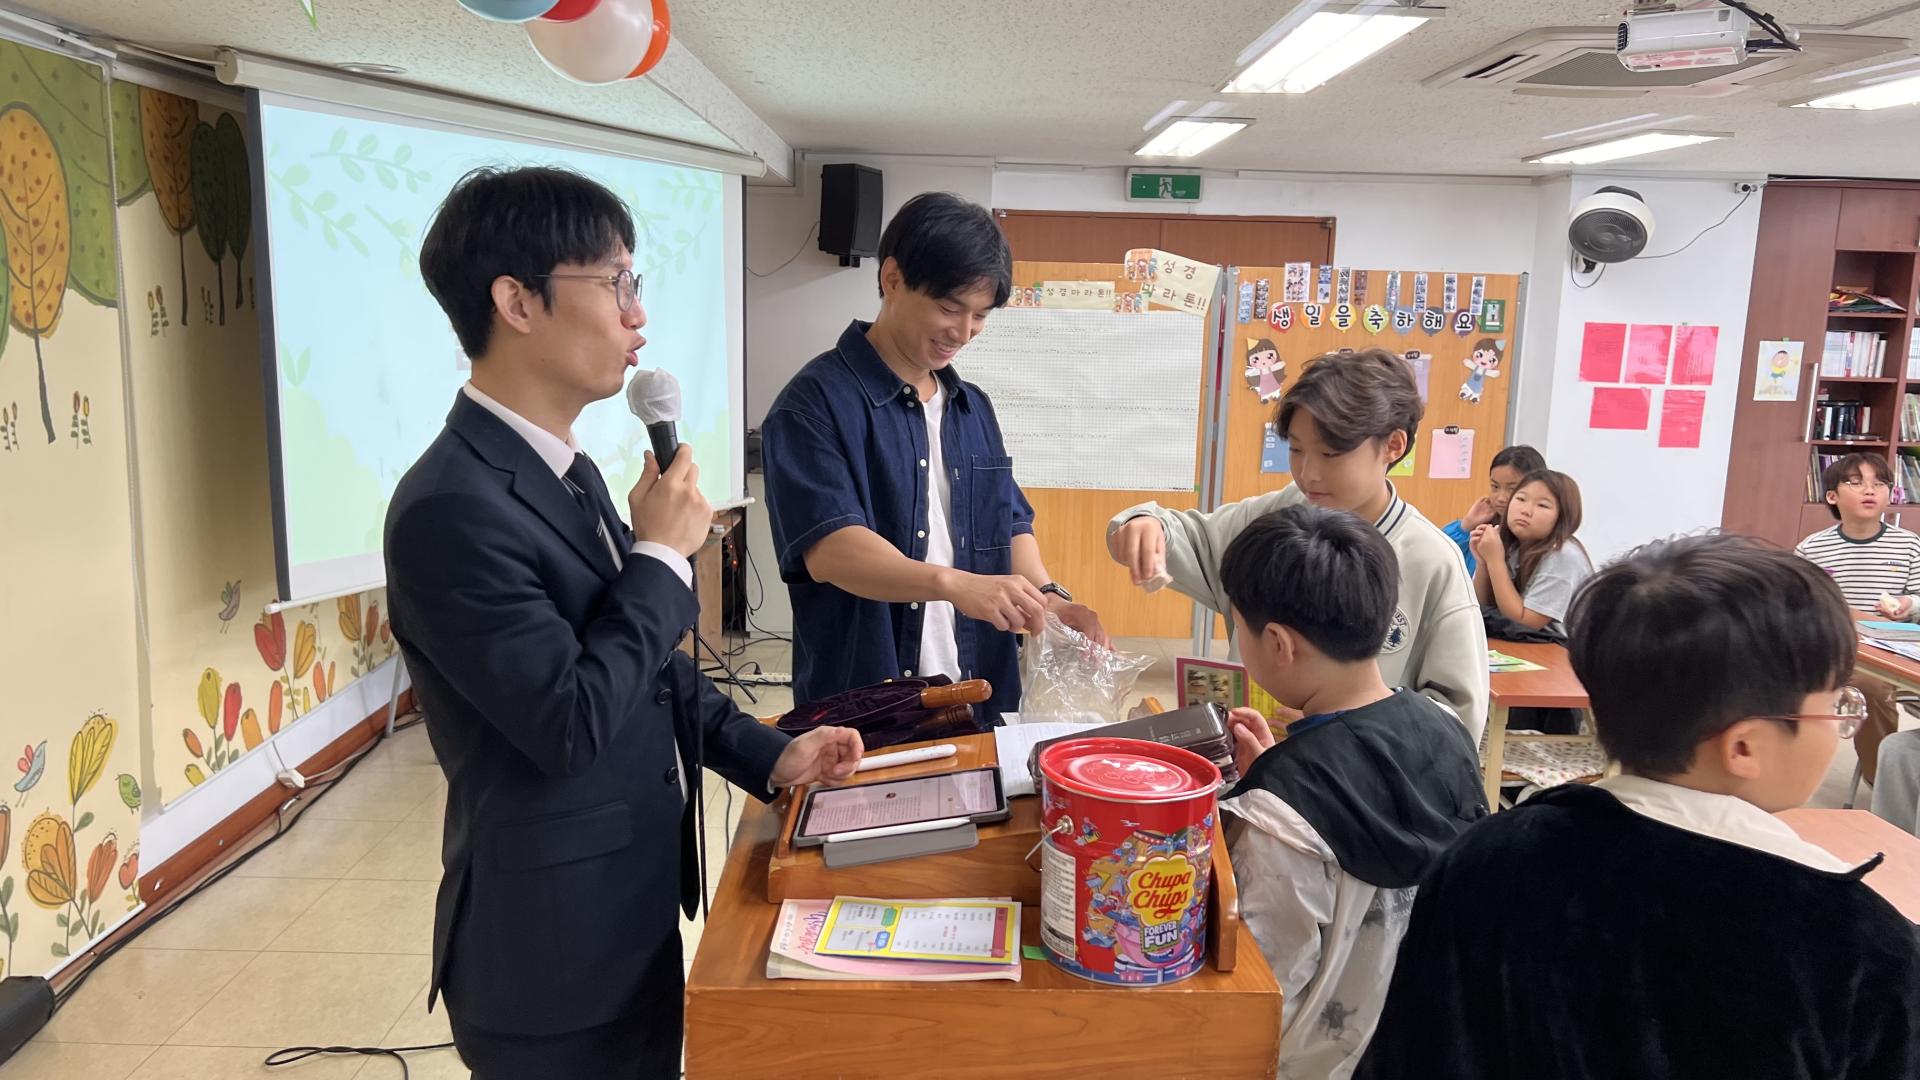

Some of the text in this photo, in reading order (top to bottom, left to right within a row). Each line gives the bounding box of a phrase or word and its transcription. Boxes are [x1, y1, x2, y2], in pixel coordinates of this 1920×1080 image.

[1138, 871, 1192, 893] Chupa
[1133, 889, 1189, 919] Chups
[1144, 921, 1177, 937] FOREVER
[1144, 930, 1178, 948] FUN
